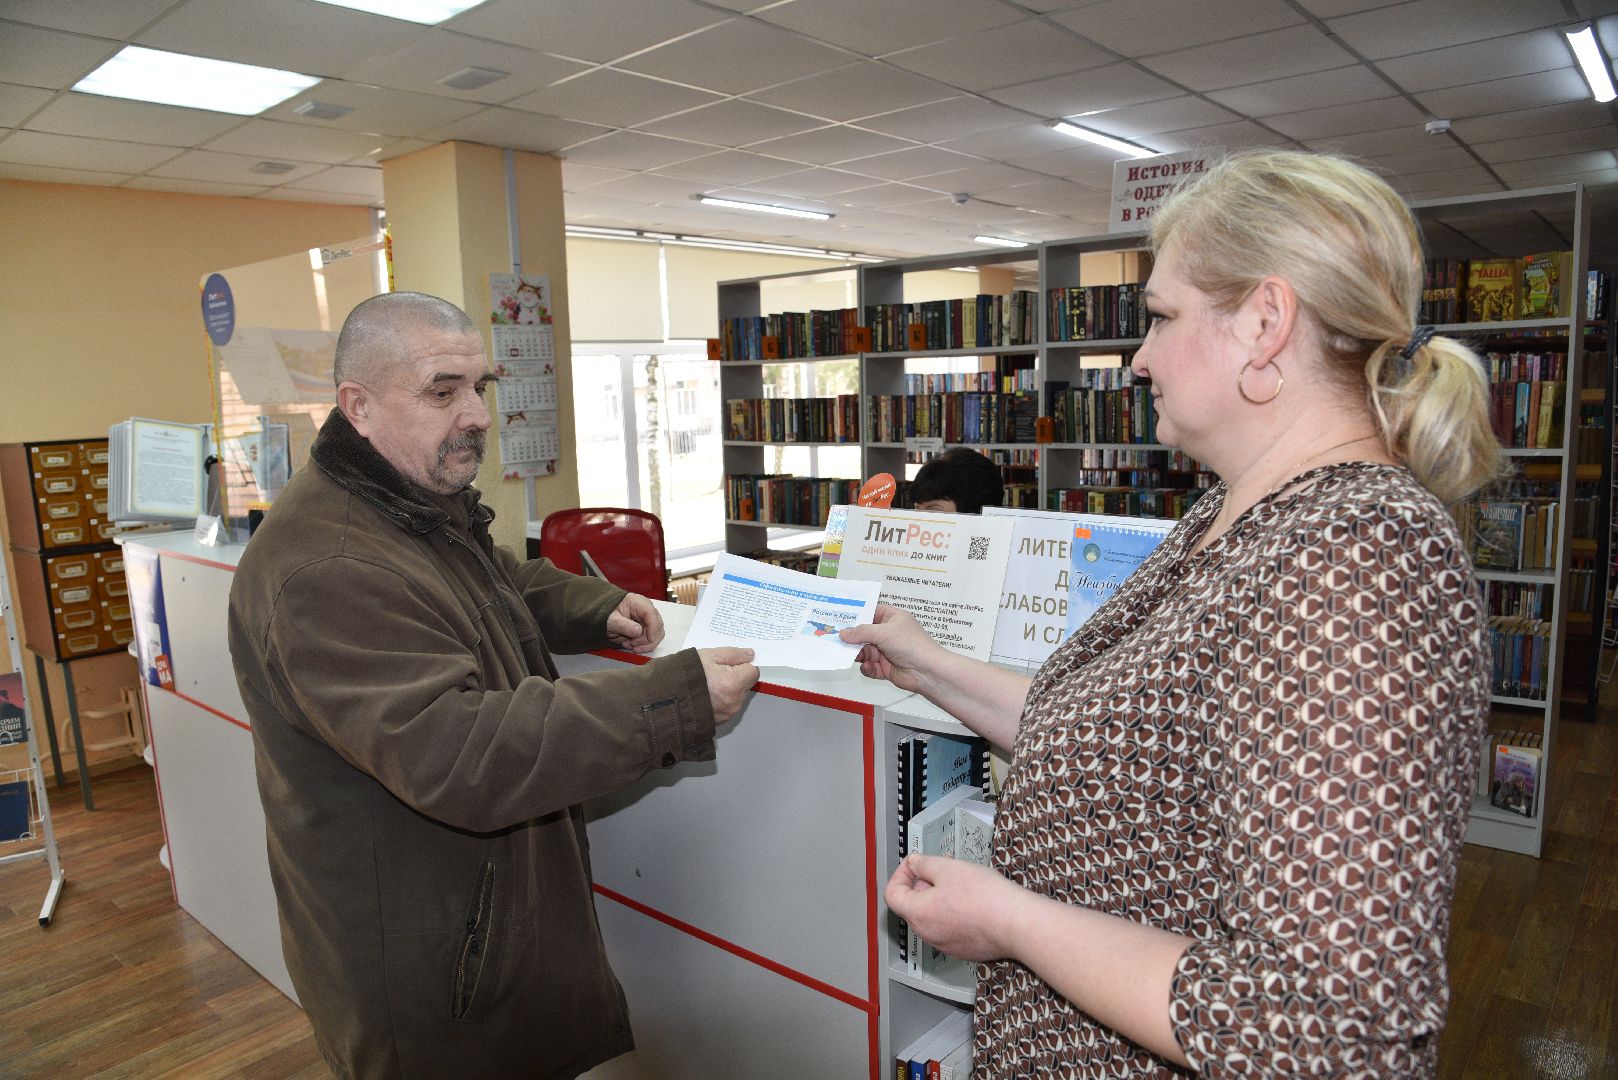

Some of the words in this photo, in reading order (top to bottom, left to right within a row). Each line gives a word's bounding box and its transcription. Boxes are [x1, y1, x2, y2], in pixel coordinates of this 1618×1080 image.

[1122, 209, 1131, 222] В
[864, 520, 951, 549] ЛитРес:
[911, 552, 924, 560] до
[926, 554, 949, 563] книг
[1018, 538, 1072, 559] ЛИТЕ
[885, 575, 920, 585] УВАЖАЕМЫЕ
[1000, 592, 1068, 617] ЛАБОВ
[1023, 623, 1036, 641] И
